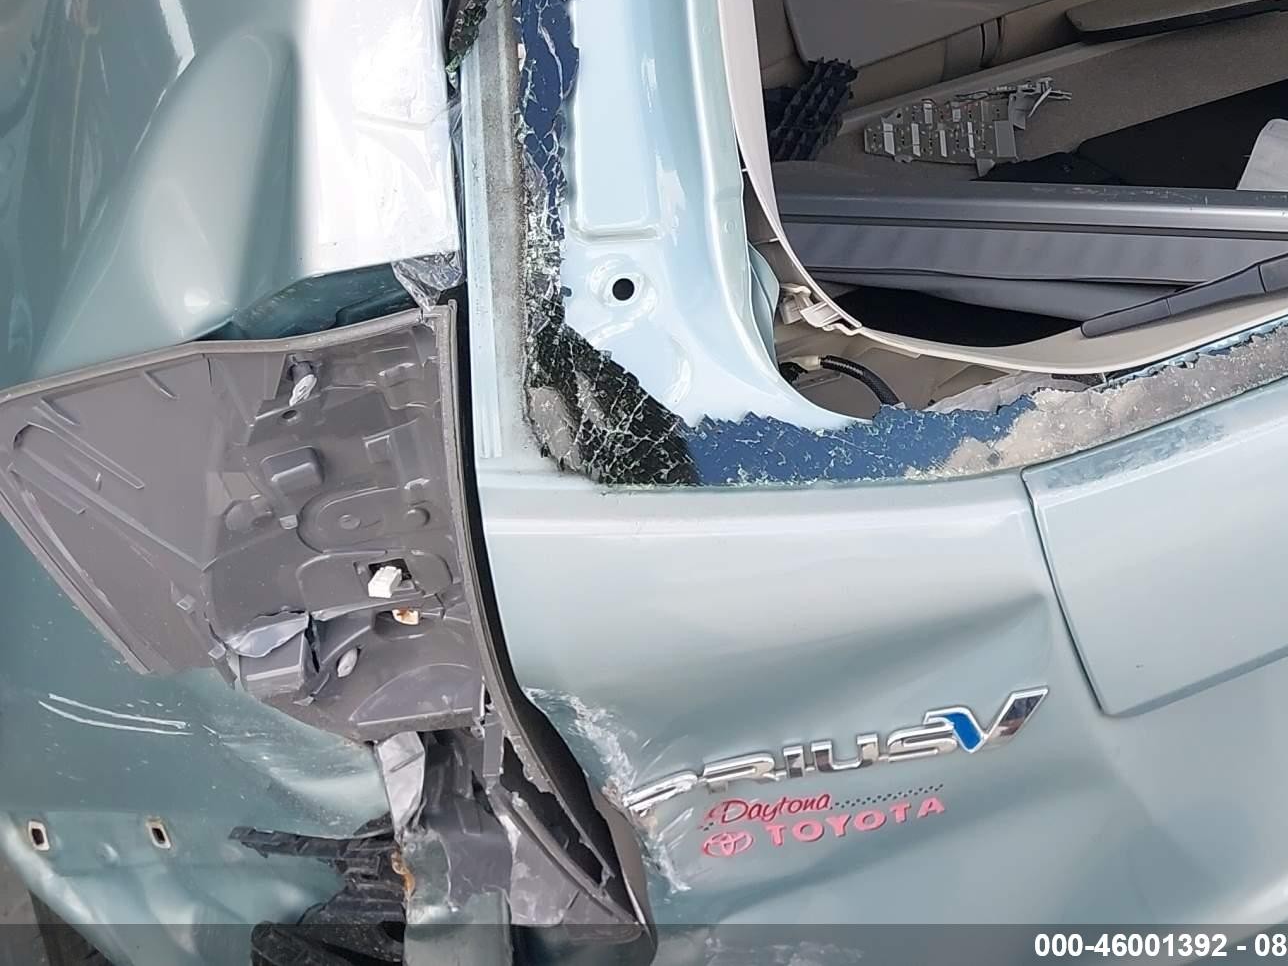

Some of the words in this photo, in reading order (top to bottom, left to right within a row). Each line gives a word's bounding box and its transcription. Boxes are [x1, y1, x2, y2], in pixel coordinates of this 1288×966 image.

[622, 716, 959, 818] PRIUS
[707, 792, 831, 824] Daytona
[766, 796, 945, 848] TOYOTA
